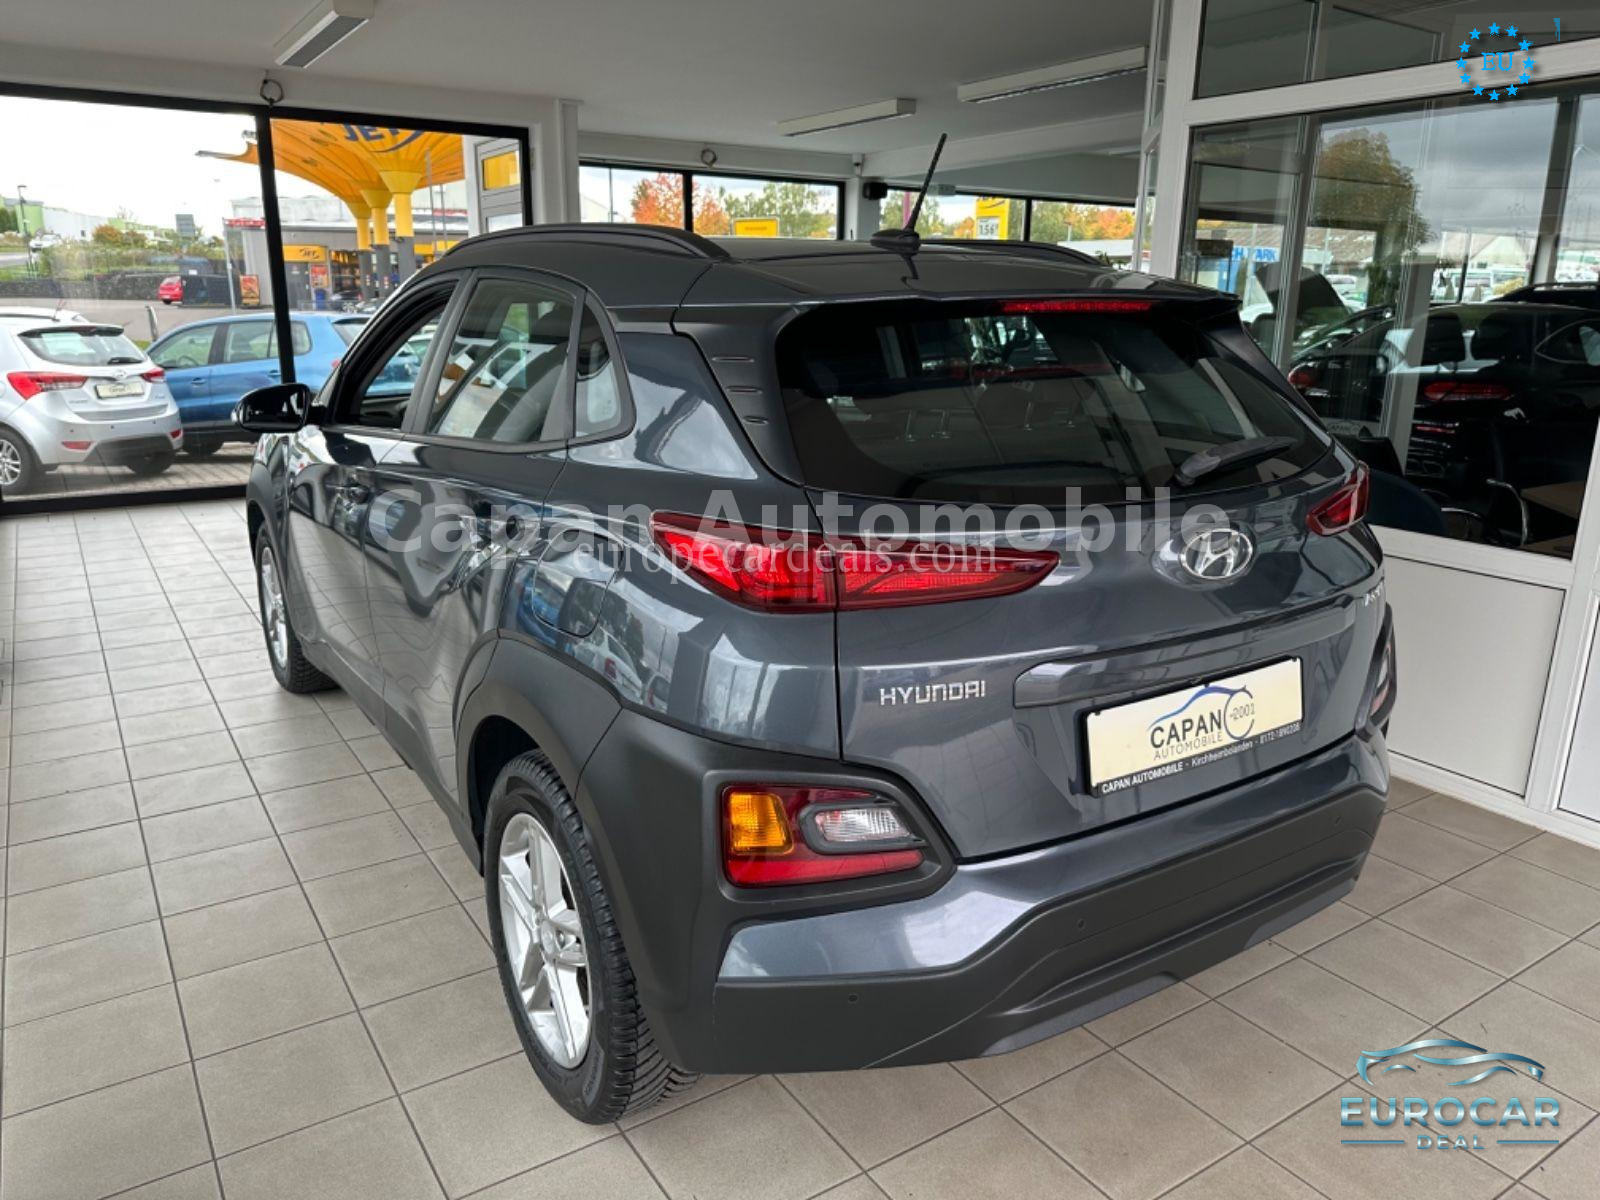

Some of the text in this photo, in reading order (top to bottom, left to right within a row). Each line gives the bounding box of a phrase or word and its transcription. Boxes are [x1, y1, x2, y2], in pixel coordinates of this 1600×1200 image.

[880, 680, 985, 706] HYUNDAI
[1150, 708, 1222, 748] CAPAN
[1153, 731, 1223, 761] AUTOMOBILE
[1102, 776, 1131, 795] CAPAN
[1131, 762, 1184, 786] AUTOMOBILE
